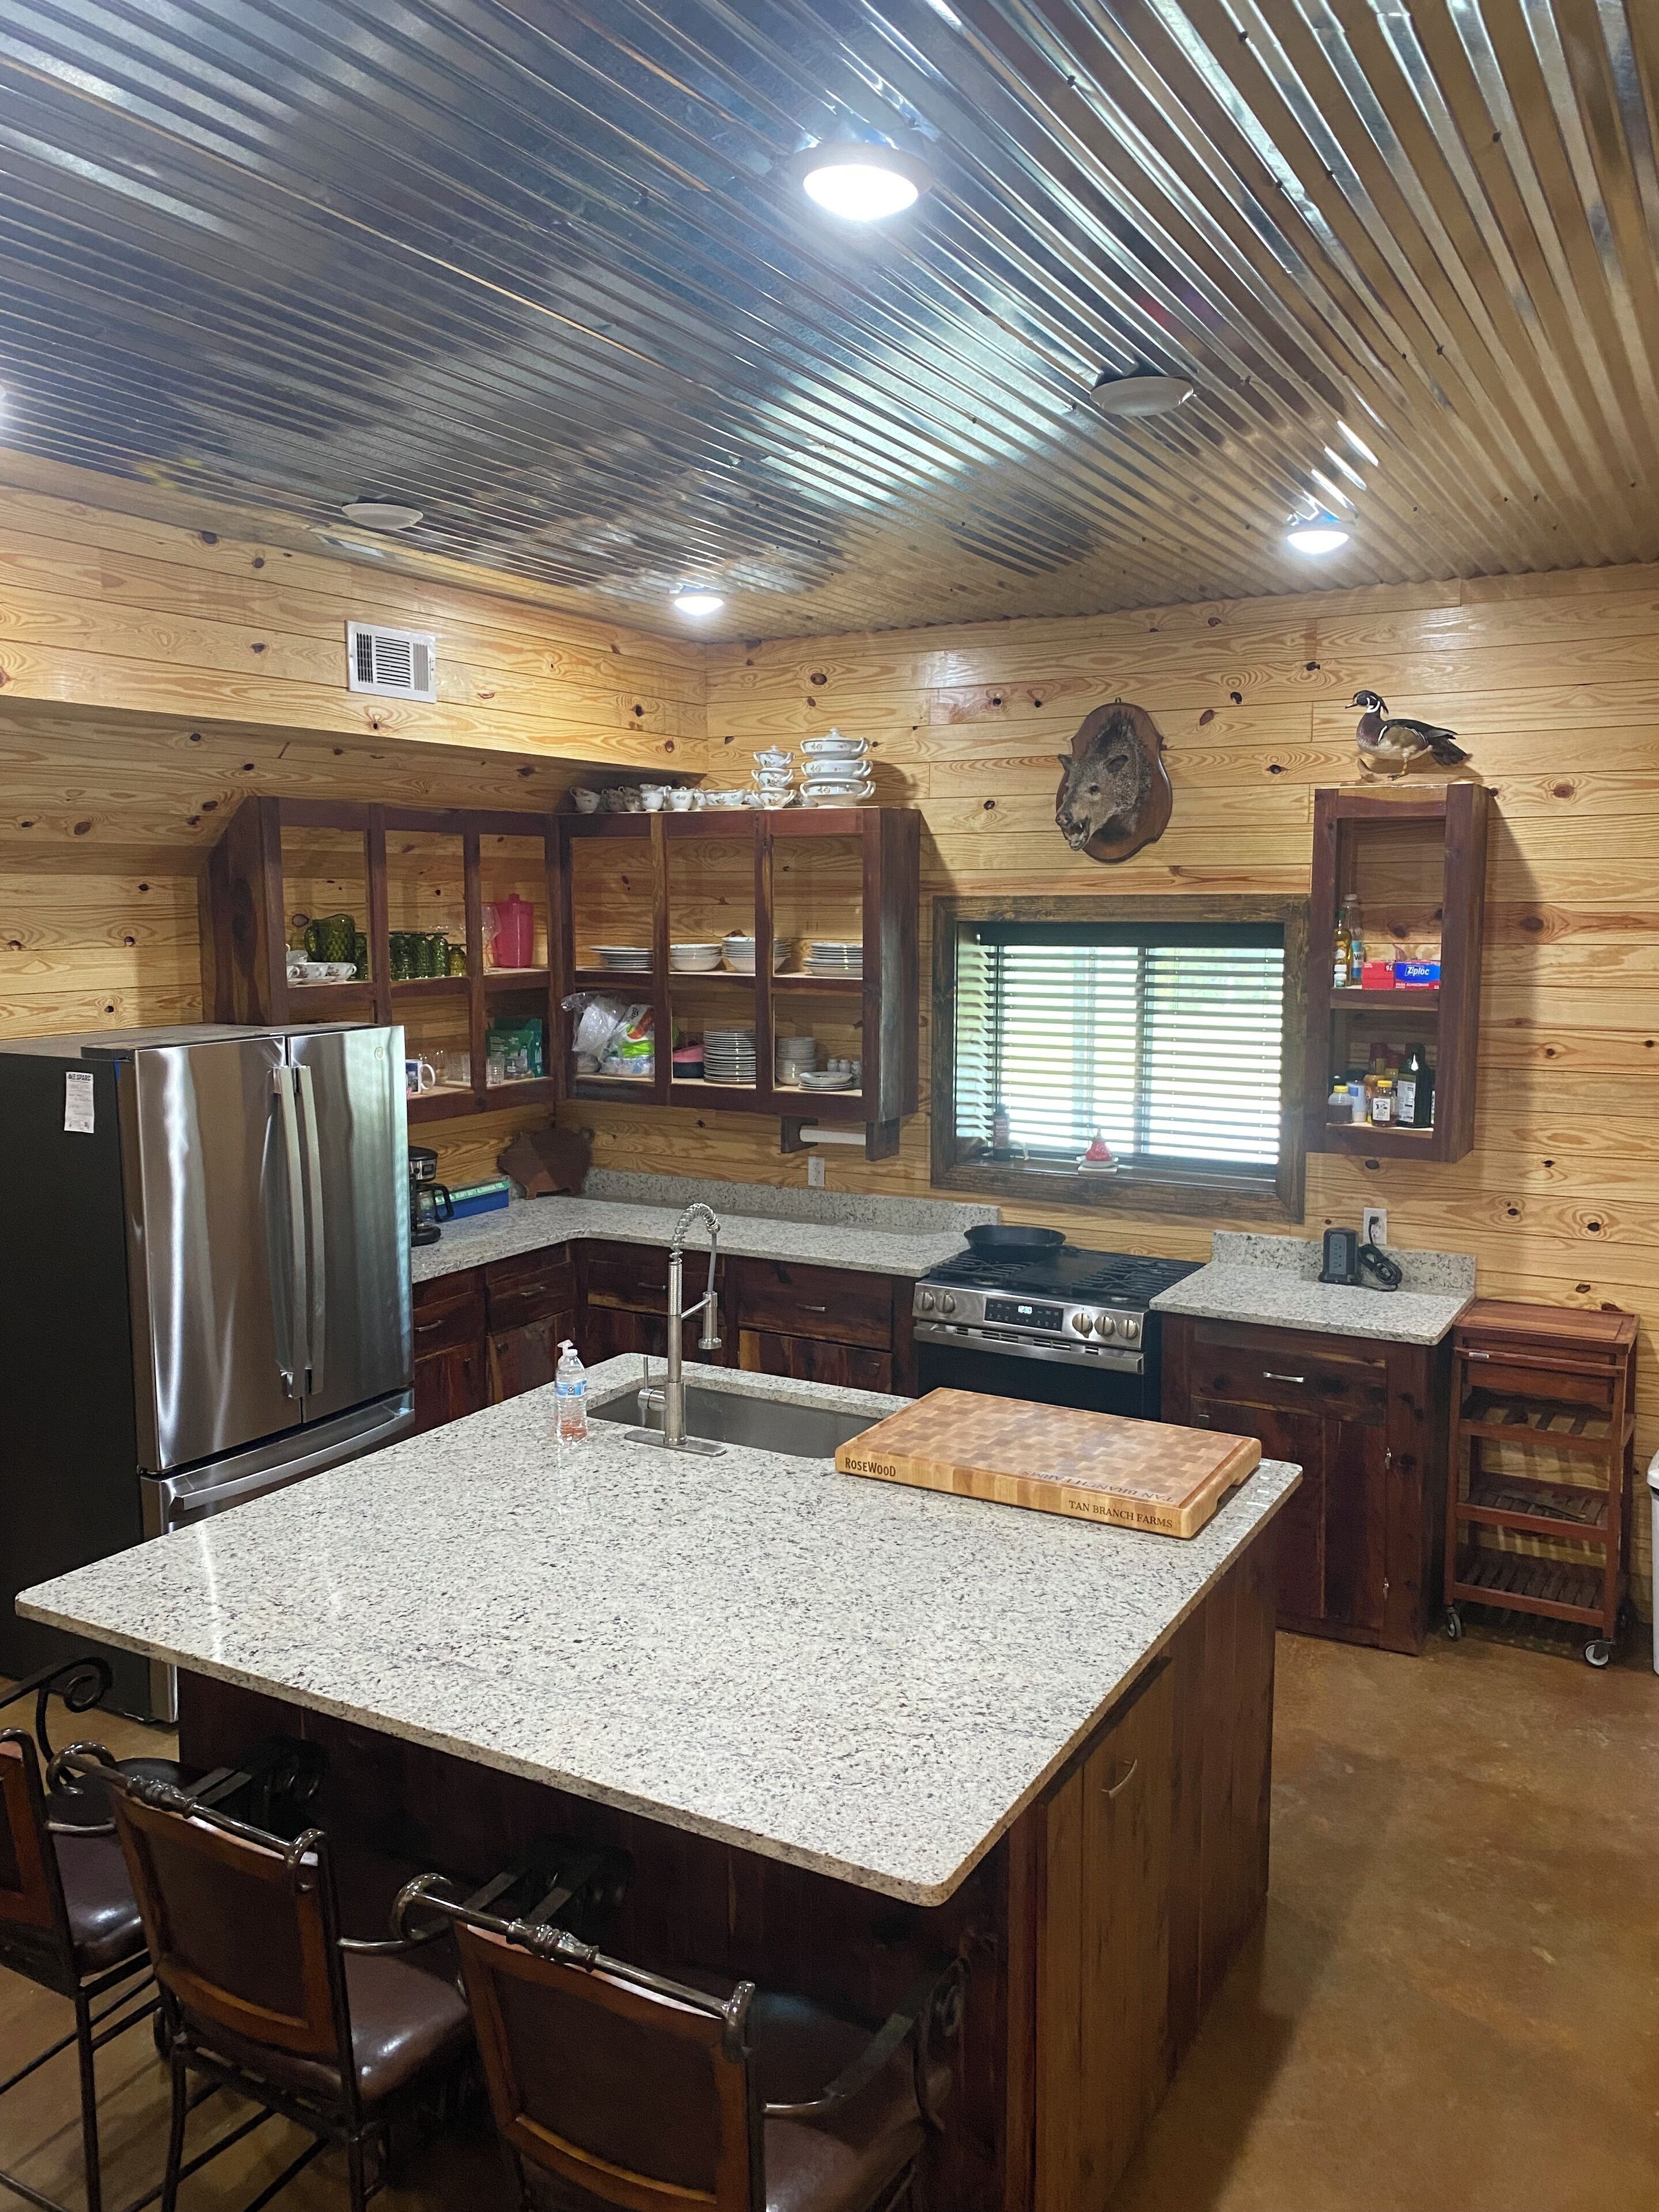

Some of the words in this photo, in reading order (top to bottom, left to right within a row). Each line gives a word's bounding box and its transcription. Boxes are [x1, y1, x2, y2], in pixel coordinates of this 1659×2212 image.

[1407, 966, 1430, 976] Ziploc
[1022, 1470, 1072, 1483] FARMS
[1075, 1481, 1138, 1494] BRANCH
[1142, 1492, 1175, 1503] TAN
[1069, 1500, 1090, 1512] TAN
[1092, 1505, 1134, 1521] BRANCH
[1137, 1513, 1173, 1528] FARMS
